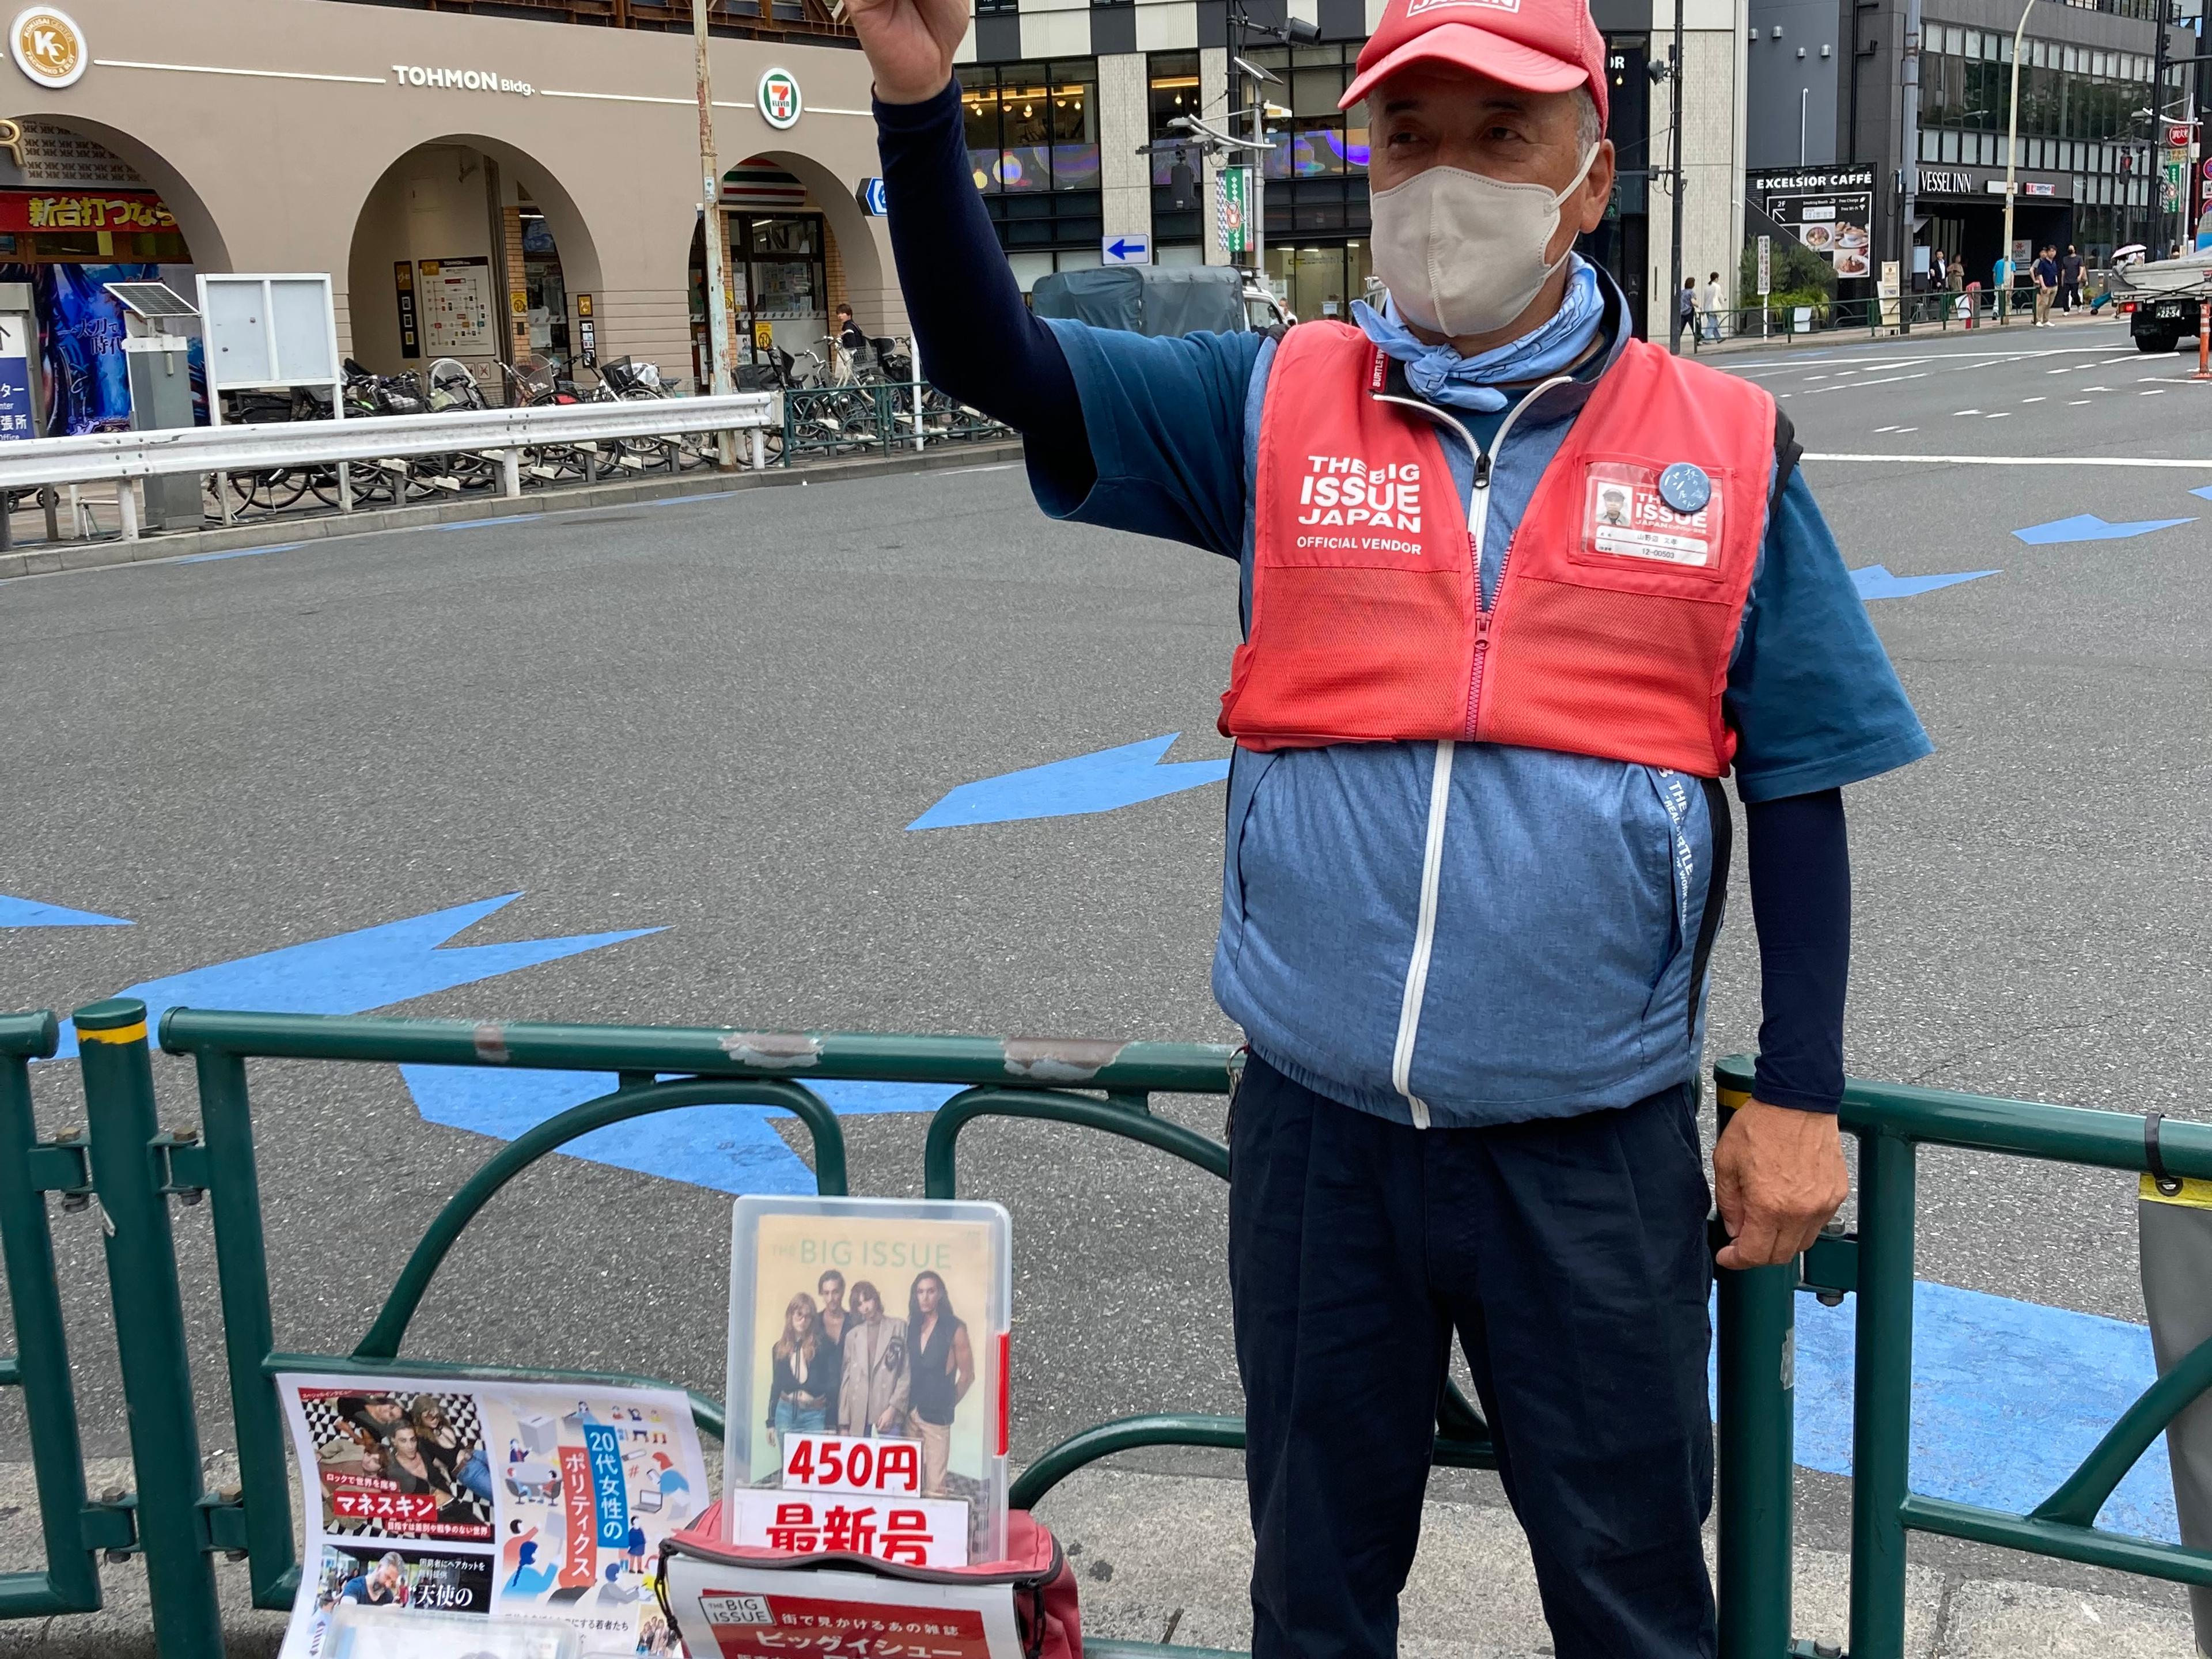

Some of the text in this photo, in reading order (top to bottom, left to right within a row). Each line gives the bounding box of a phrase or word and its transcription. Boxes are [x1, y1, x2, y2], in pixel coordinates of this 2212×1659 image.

[392, 65, 535, 97] TOHMON Bldg.
[1757, 171, 1872, 189] EXCELSIOR CAFFÉ
[1922, 171, 1971, 193] VESSEL INN
[29, 197, 176, 226] 新台打つなら
[1372, 359, 1384, 387] BURTLE
[1308, 456, 1420, 484] THE BIG
[1300, 475, 1421, 514] ISSUE
[1636, 491, 1662, 505] TH
[1298, 509, 1421, 533] JAPAN
[1635, 519, 1669, 529] JAPAN
[1297, 536, 1422, 555] OFFICIAL VENDOR
[1642, 548, 1675, 559] 12-00503
[1668, 781, 1687, 813] THE
[800, 1239, 852, 1266] BIG
[863, 1240, 952, 1270] ISSUE
[788, 1440, 918, 1491] 450円
[589, 1431, 624, 1540] 20代女性の
[336, 1493, 434, 1517] マネスキン
[565, 1452, 591, 1578] ポリティクス
[766, 1502, 934, 1566] 最新号
[714, 1611, 768, 1622] ISSUE
[726, 1599, 757, 1611] BIG
[781, 1613, 960, 1637] 街で見かけるあの雑誌
[755, 1631, 963, 1657] ビッグイシュー
